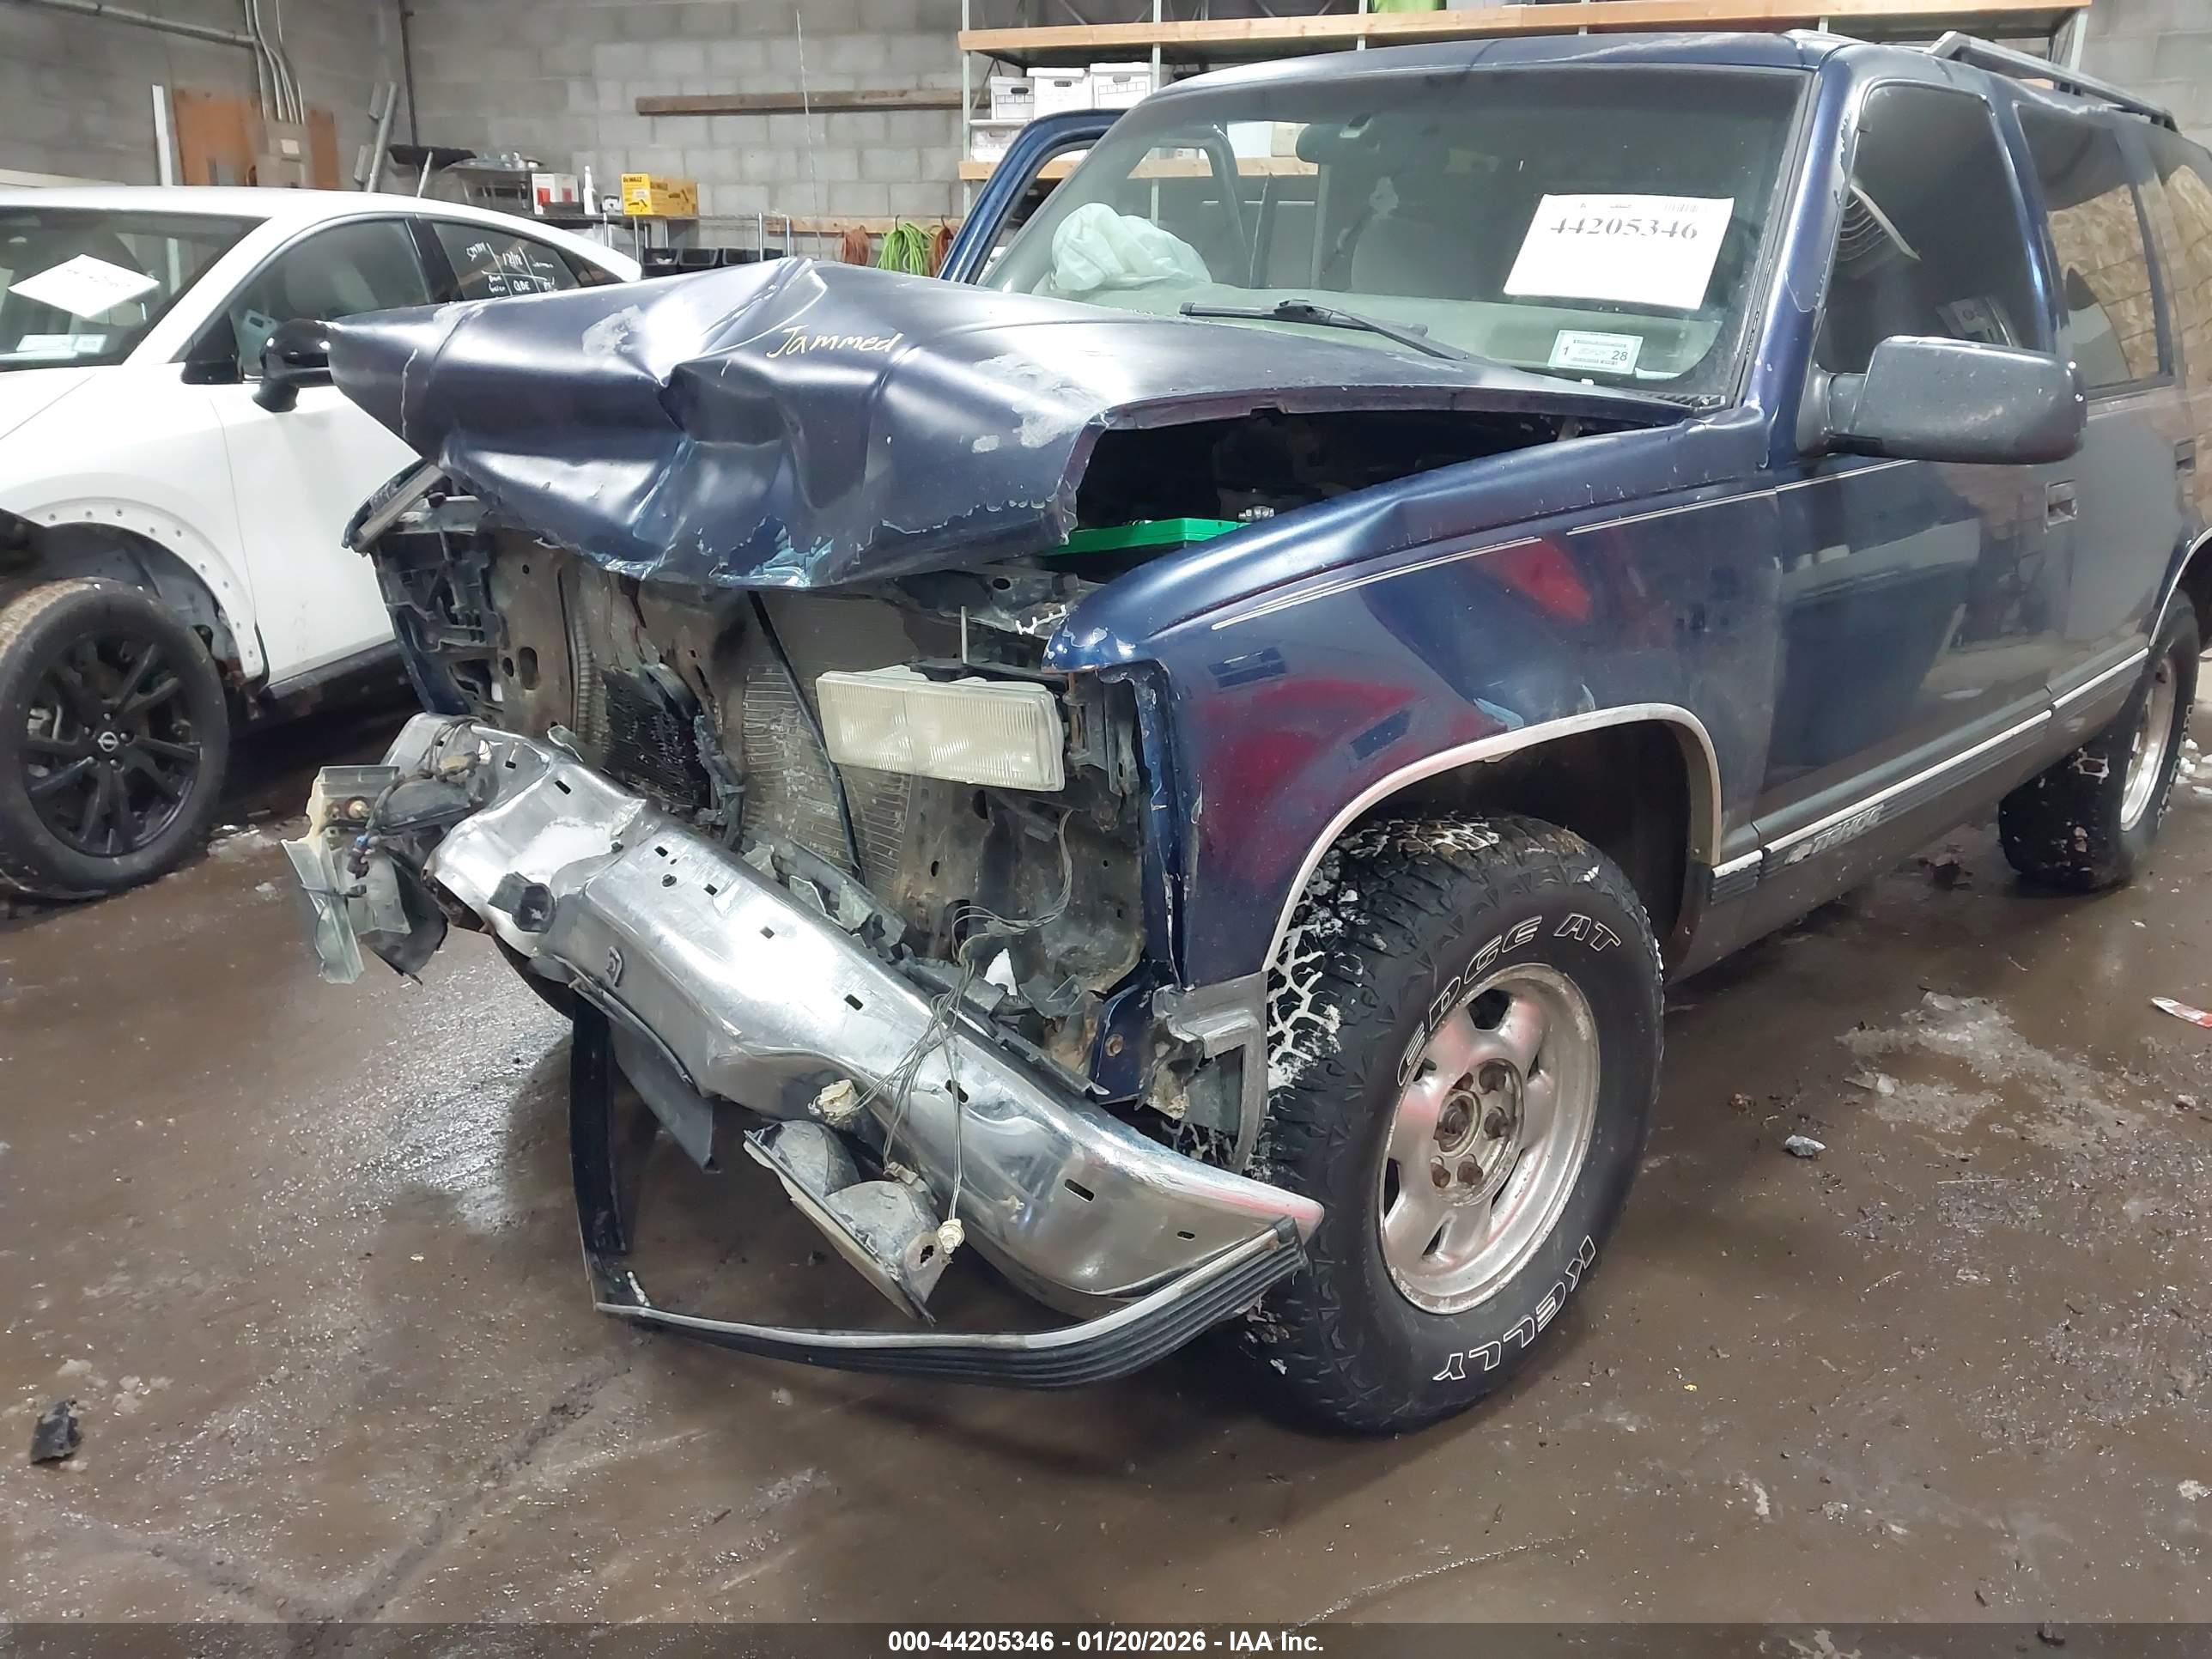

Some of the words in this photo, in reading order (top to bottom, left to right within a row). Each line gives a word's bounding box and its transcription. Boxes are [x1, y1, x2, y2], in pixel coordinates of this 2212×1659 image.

[1549, 216, 1699, 240] 44205346
[766, 324, 904, 358] Jammed
[1611, 349, 1629, 362] 28
[1397, 915, 1543, 1087] EDGE
[1553, 912, 1621, 951] AT
[1431, 1234, 1596, 1381] KELLY
